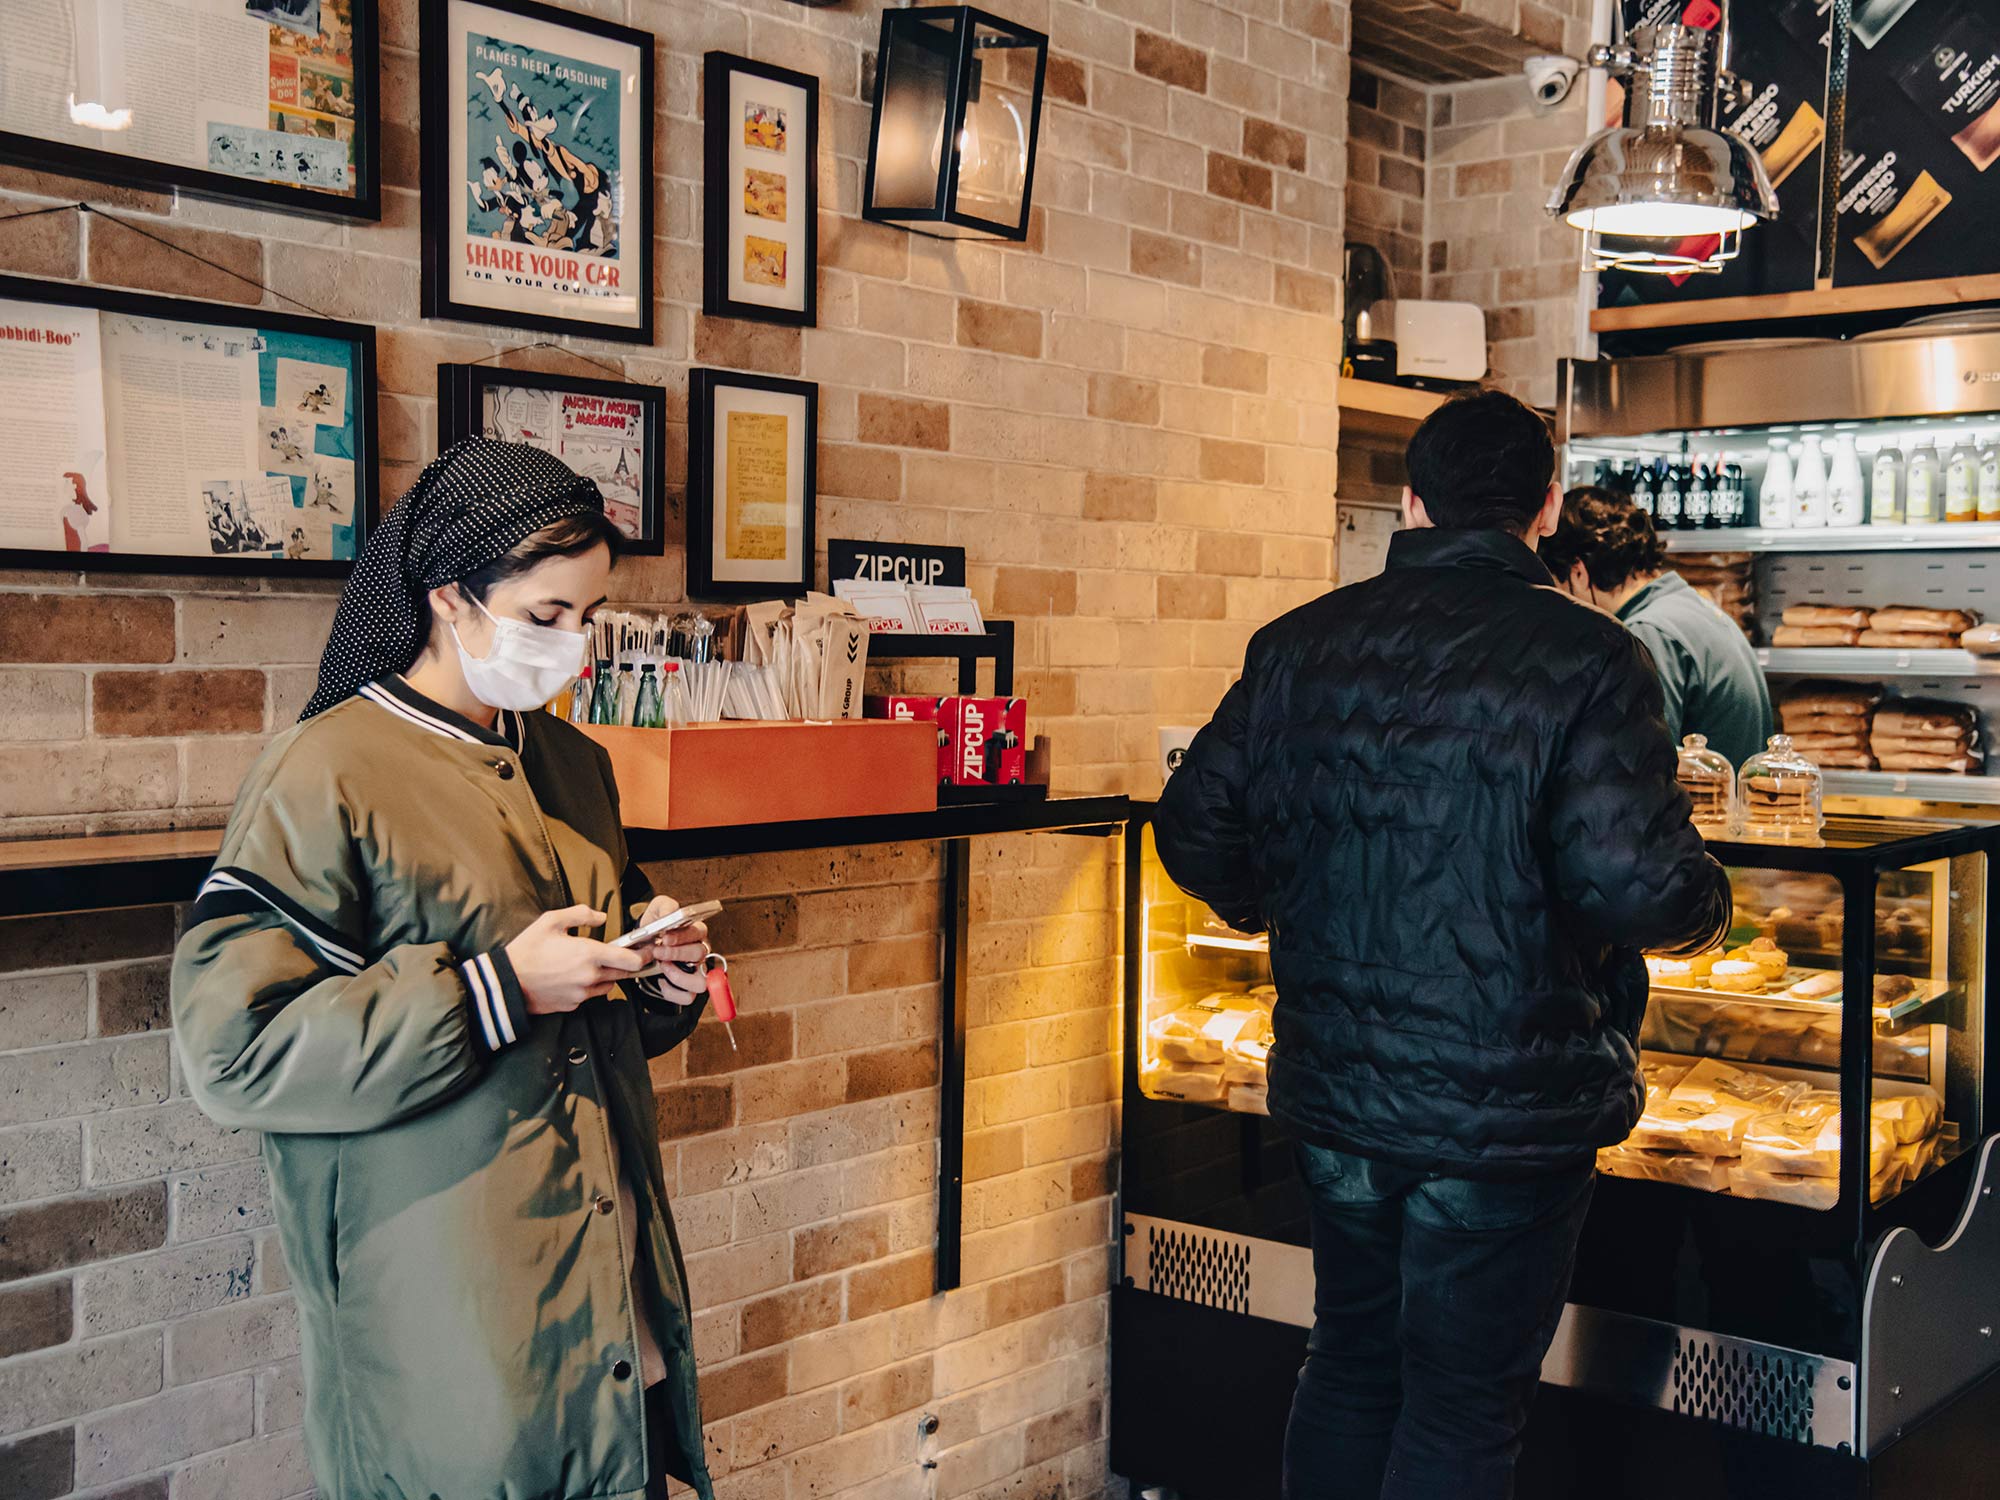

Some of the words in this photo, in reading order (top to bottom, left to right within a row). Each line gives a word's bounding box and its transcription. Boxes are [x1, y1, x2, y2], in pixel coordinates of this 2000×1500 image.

[475, 46, 517, 67] PLANES
[521, 57, 550, 75] NEED
[555, 66, 607, 90] GASOLINE
[1941, 54, 2000, 113] TURKISH
[1836, 151, 1897, 214] ESPRESSO
[1853, 170, 1896, 214] BLEND
[466, 243, 525, 273] SHARE
[529, 253, 579, 281] YOUR
[585, 263, 620, 288] CAR
[505, 276, 543, 288] YOUR
[854, 553, 945, 586] ZIPCUP
[869, 618, 902, 631] IPCUP
[930, 622, 970, 633] ZIPCUP
[843, 678, 852, 710] GROUP
[963, 703, 985, 780] ZIPCUP
